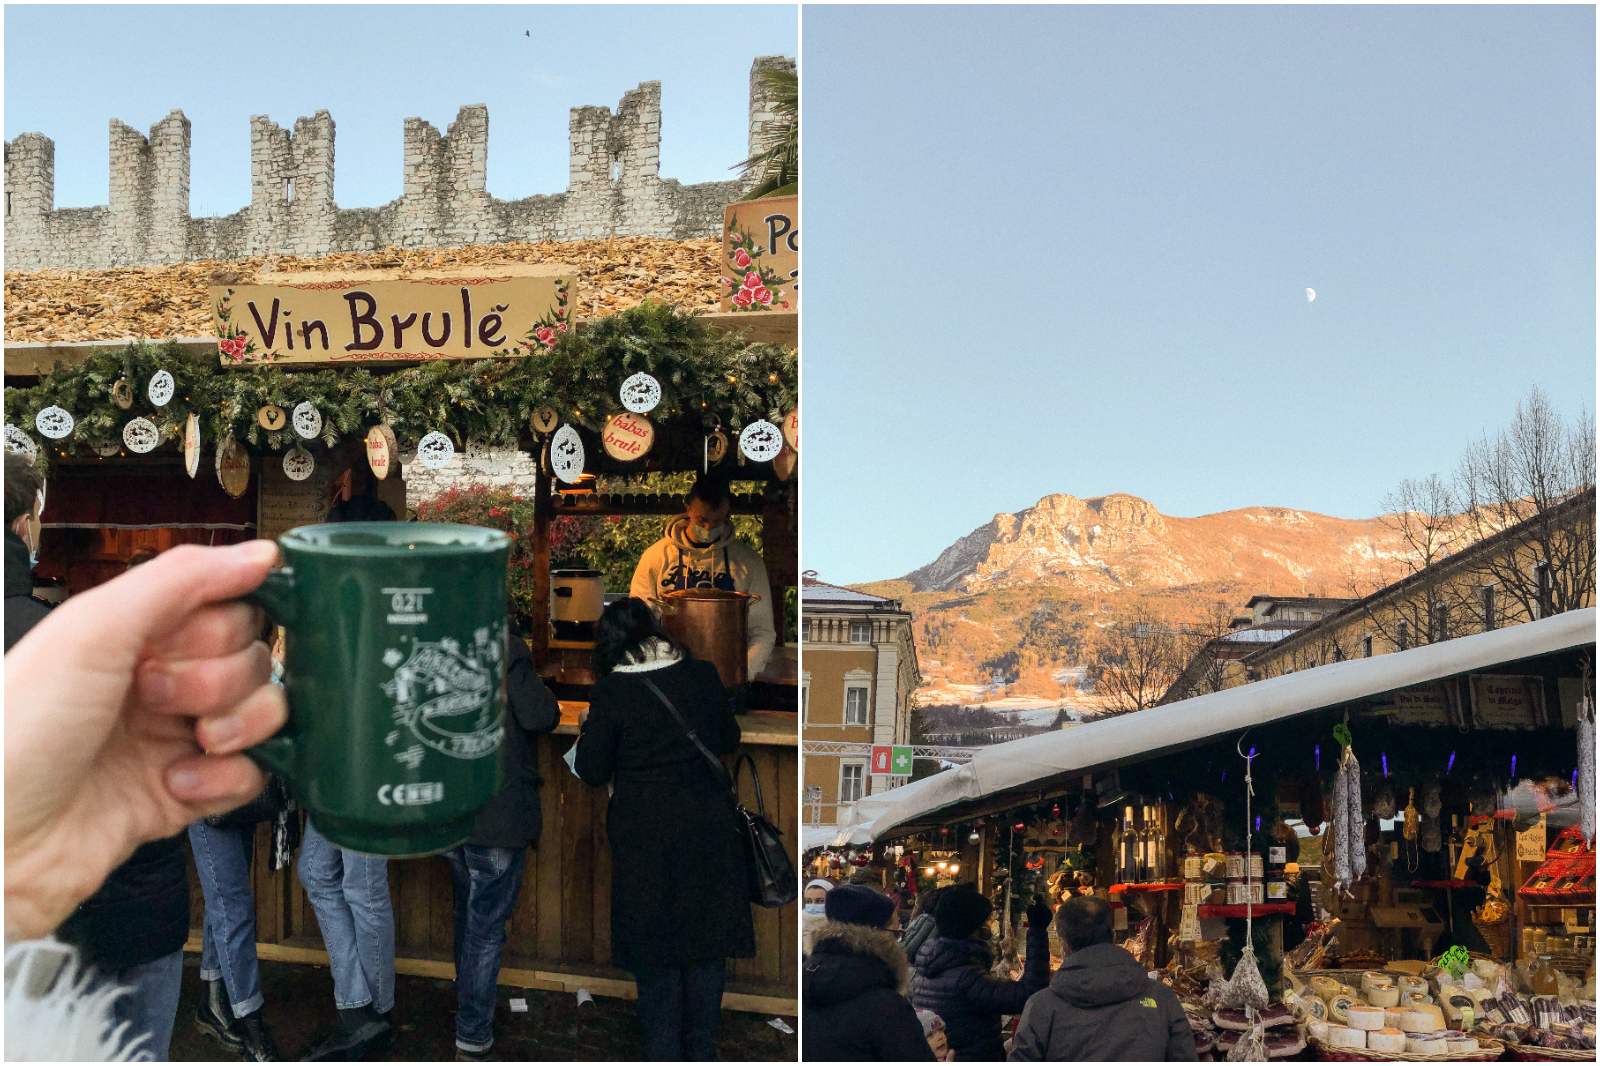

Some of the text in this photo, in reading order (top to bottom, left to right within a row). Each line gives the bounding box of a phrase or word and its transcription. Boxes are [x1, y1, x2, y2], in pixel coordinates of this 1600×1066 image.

[248, 297, 330, 350] Vin
[612, 415, 649, 438] babas
[368, 437, 384, 450] babas
